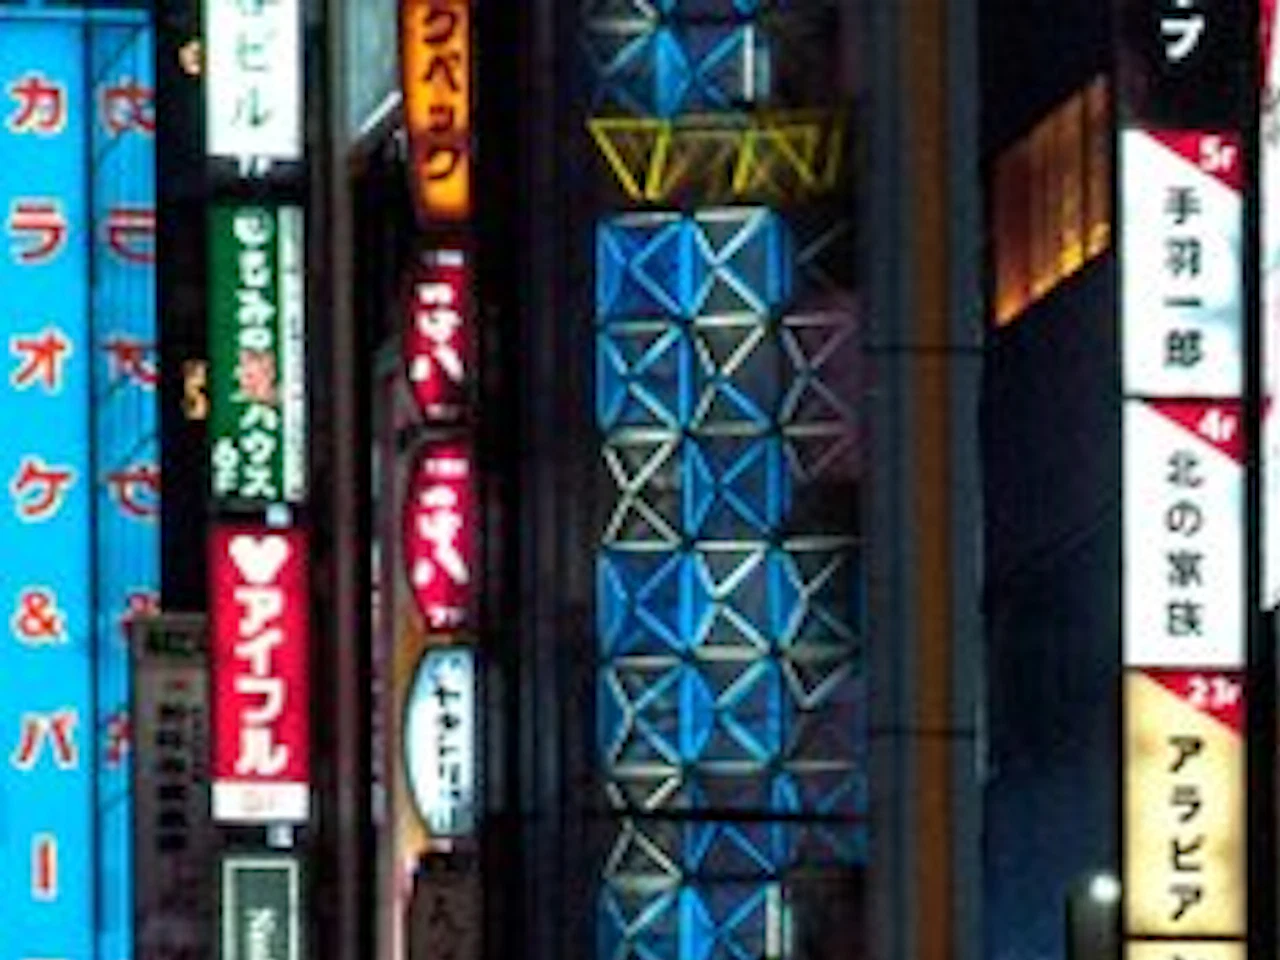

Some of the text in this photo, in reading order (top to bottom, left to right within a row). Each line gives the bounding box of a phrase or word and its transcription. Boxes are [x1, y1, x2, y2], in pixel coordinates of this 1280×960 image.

[1163, 187, 1204, 370] 手羽一郎
[1164, 452, 1205, 637] 北の家族
[235, 589, 289, 775] アイフル
